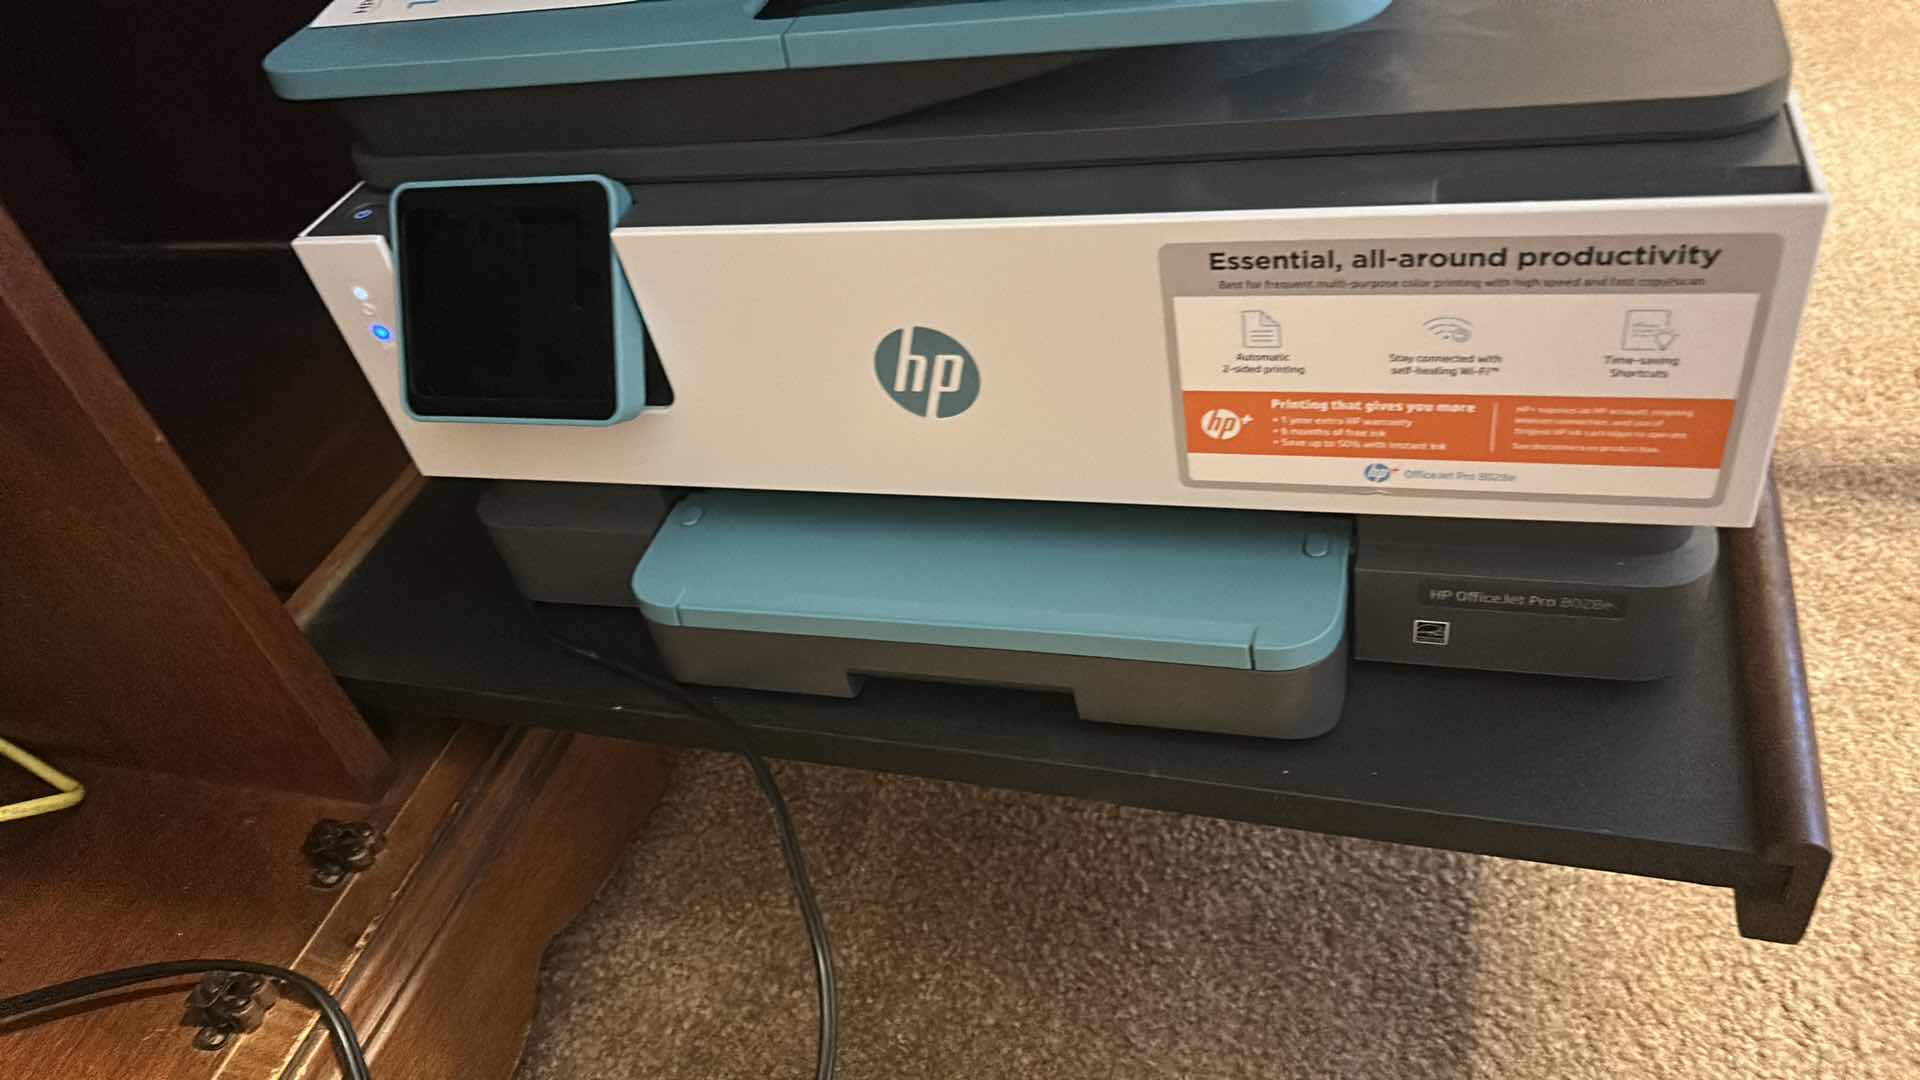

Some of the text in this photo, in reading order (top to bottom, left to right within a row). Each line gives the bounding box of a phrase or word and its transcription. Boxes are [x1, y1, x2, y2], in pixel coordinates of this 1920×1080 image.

[1208, 243, 1723, 272] Essential, all-around productivity
[1236, 353, 1291, 362] Automatic
[893, 323, 966, 419] hp
[1221, 364, 1306, 375] 2-sided printing
[1270, 398, 1477, 414] Printing that gives you more
[1429, 588, 1453, 601] HP
[1455, 590, 1525, 606] OfficeJet
[1528, 595, 1557, 608] Pro
